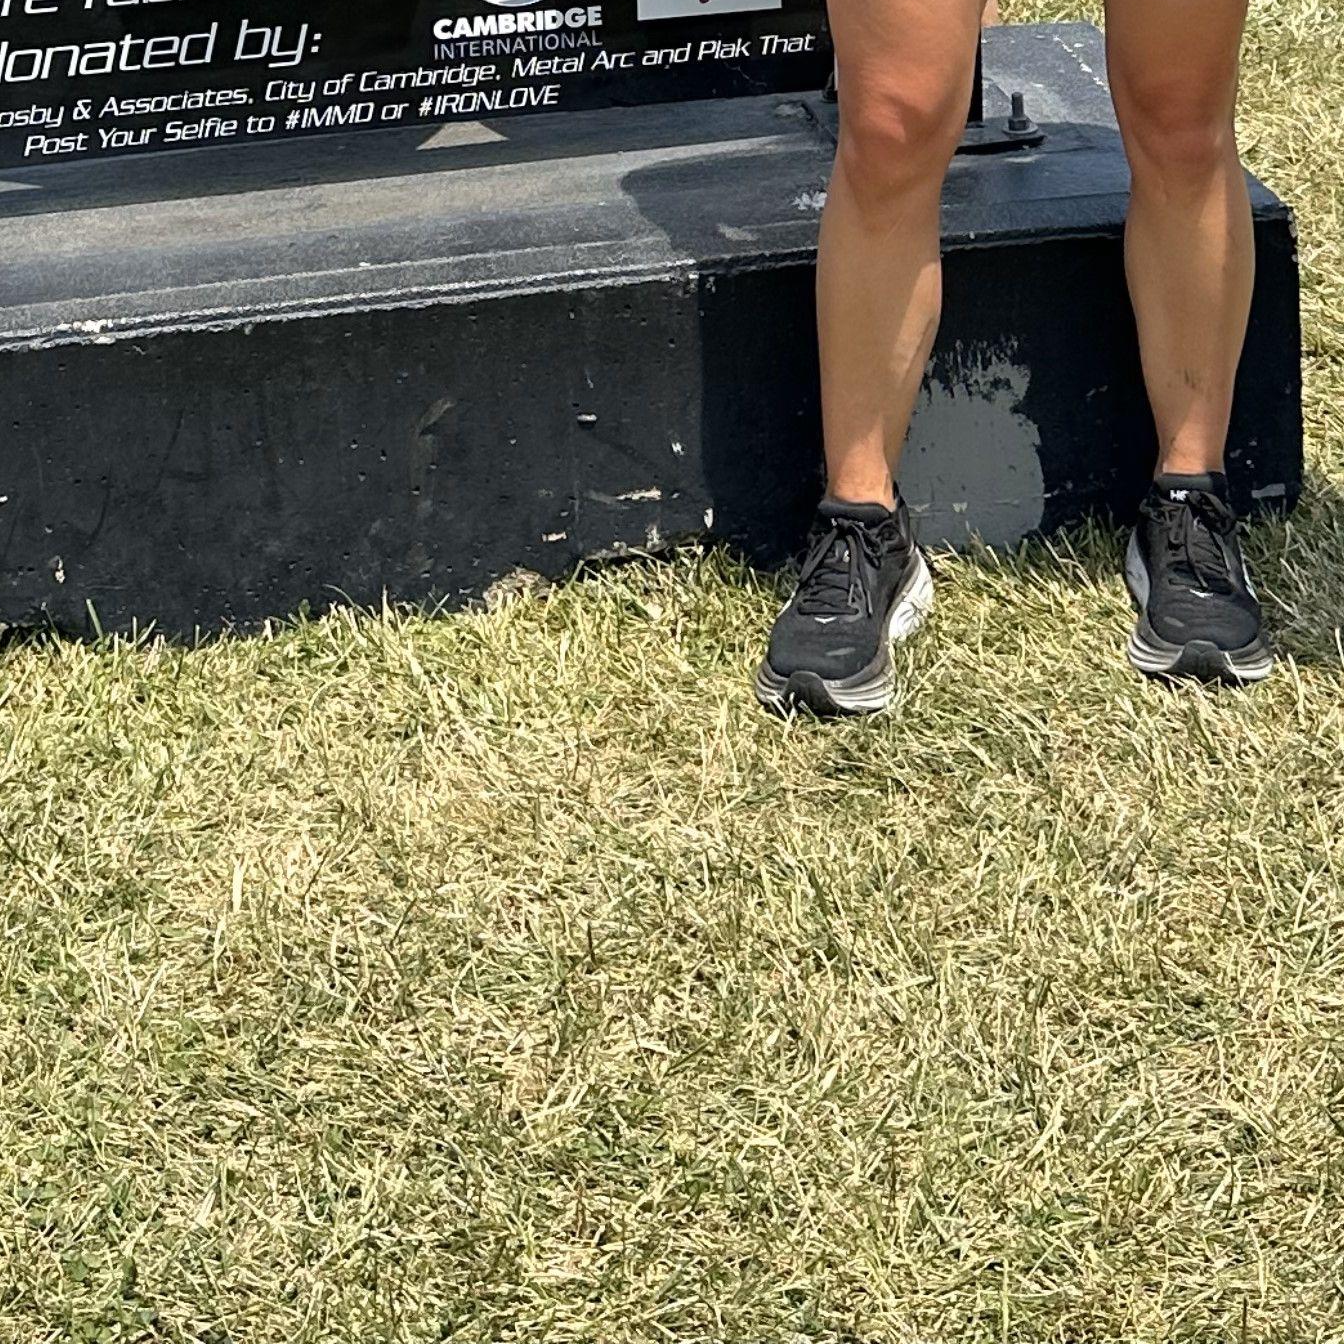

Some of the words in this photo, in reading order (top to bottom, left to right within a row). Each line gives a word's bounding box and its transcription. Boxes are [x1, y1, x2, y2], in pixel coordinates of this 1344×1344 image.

[234, 18, 323, 68] by:
[433, 5, 603, 40] CAMBRIDGE
[434, 30, 603, 61] INTERNATIONAL
[73, 101, 92, 121] &
[264, 80, 315, 102] City
[321, 72, 355, 96] of
[511, 50, 586, 78] Metal
[594, 50, 637, 72] Arc
[642, 46, 692, 66] and
[697, 40, 753, 60] Plak
[760, 33, 816, 54] That
[23, 133, 89, 157] Post
[98, 127, 158, 150] Your
[162, 117, 238, 143] Selfie
[246, 114, 276, 133] to
[285, 101, 374, 130] #IMMD
[380, 102, 410, 120] or
[419, 83, 562, 118] #IRONLOVE
